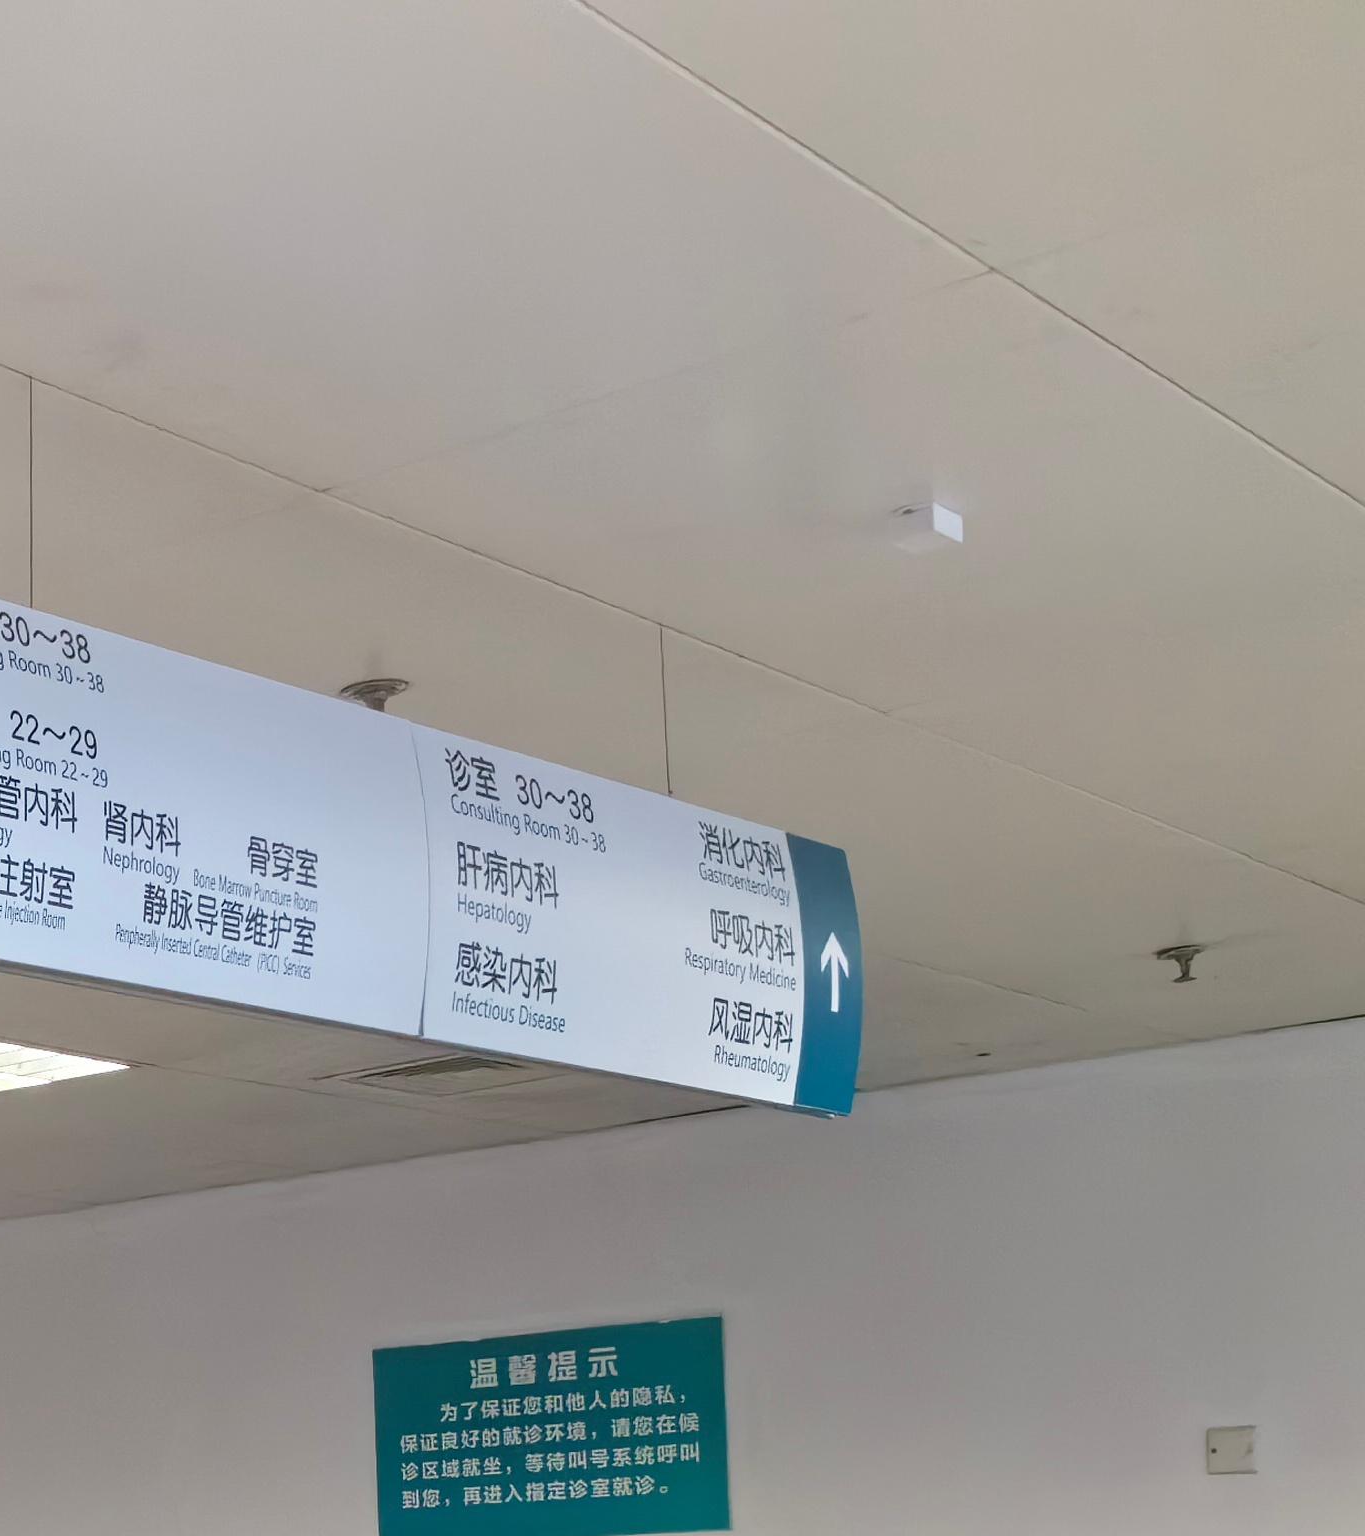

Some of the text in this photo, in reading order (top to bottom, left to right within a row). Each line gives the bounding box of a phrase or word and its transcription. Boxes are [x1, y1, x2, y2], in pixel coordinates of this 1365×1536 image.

[8, 650, 51, 679] Room
[16, 748, 57, 776] Room
[445, 748, 500, 801] 诊室
[103, 800, 181, 857] 肾内科
[450, 793, 520, 836] Consulting
[523, 813, 561, 841] Room
[103, 846, 180, 886] Nephrology
[247, 836, 318, 889] 骨穿室
[457, 840, 559, 909] 肝病内科
[698, 821, 786, 882] 消化内科
[193, 868, 318, 913] Bone Marrow Puncture Room
[699, 862, 791, 907] Gastroenterology
[4, 901, 41, 926] Injection
[42, 908, 66, 931] Room
[142, 881, 317, 957] 静脉导管维护室
[457, 892, 532, 935] Hepatology
[115, 923, 161, 955] Peripherally
[161, 932, 192, 956] Inserted
[193, 938, 220, 961] Central
[220, 943, 252, 968] Catheter
[282, 956, 312, 980] Services
[710, 908, 795, 966] 呼吸内科
[454, 941, 558, 1005] 感染内科
[684, 947, 797, 991] Respiratory Medicine
[452, 991, 566, 1033] Infectious Disease
[708, 997, 793, 1054] 风湿内科
[714, 1045, 791, 1083] Rheumatology
[470, 1346, 619, 1389] 温馨提示
